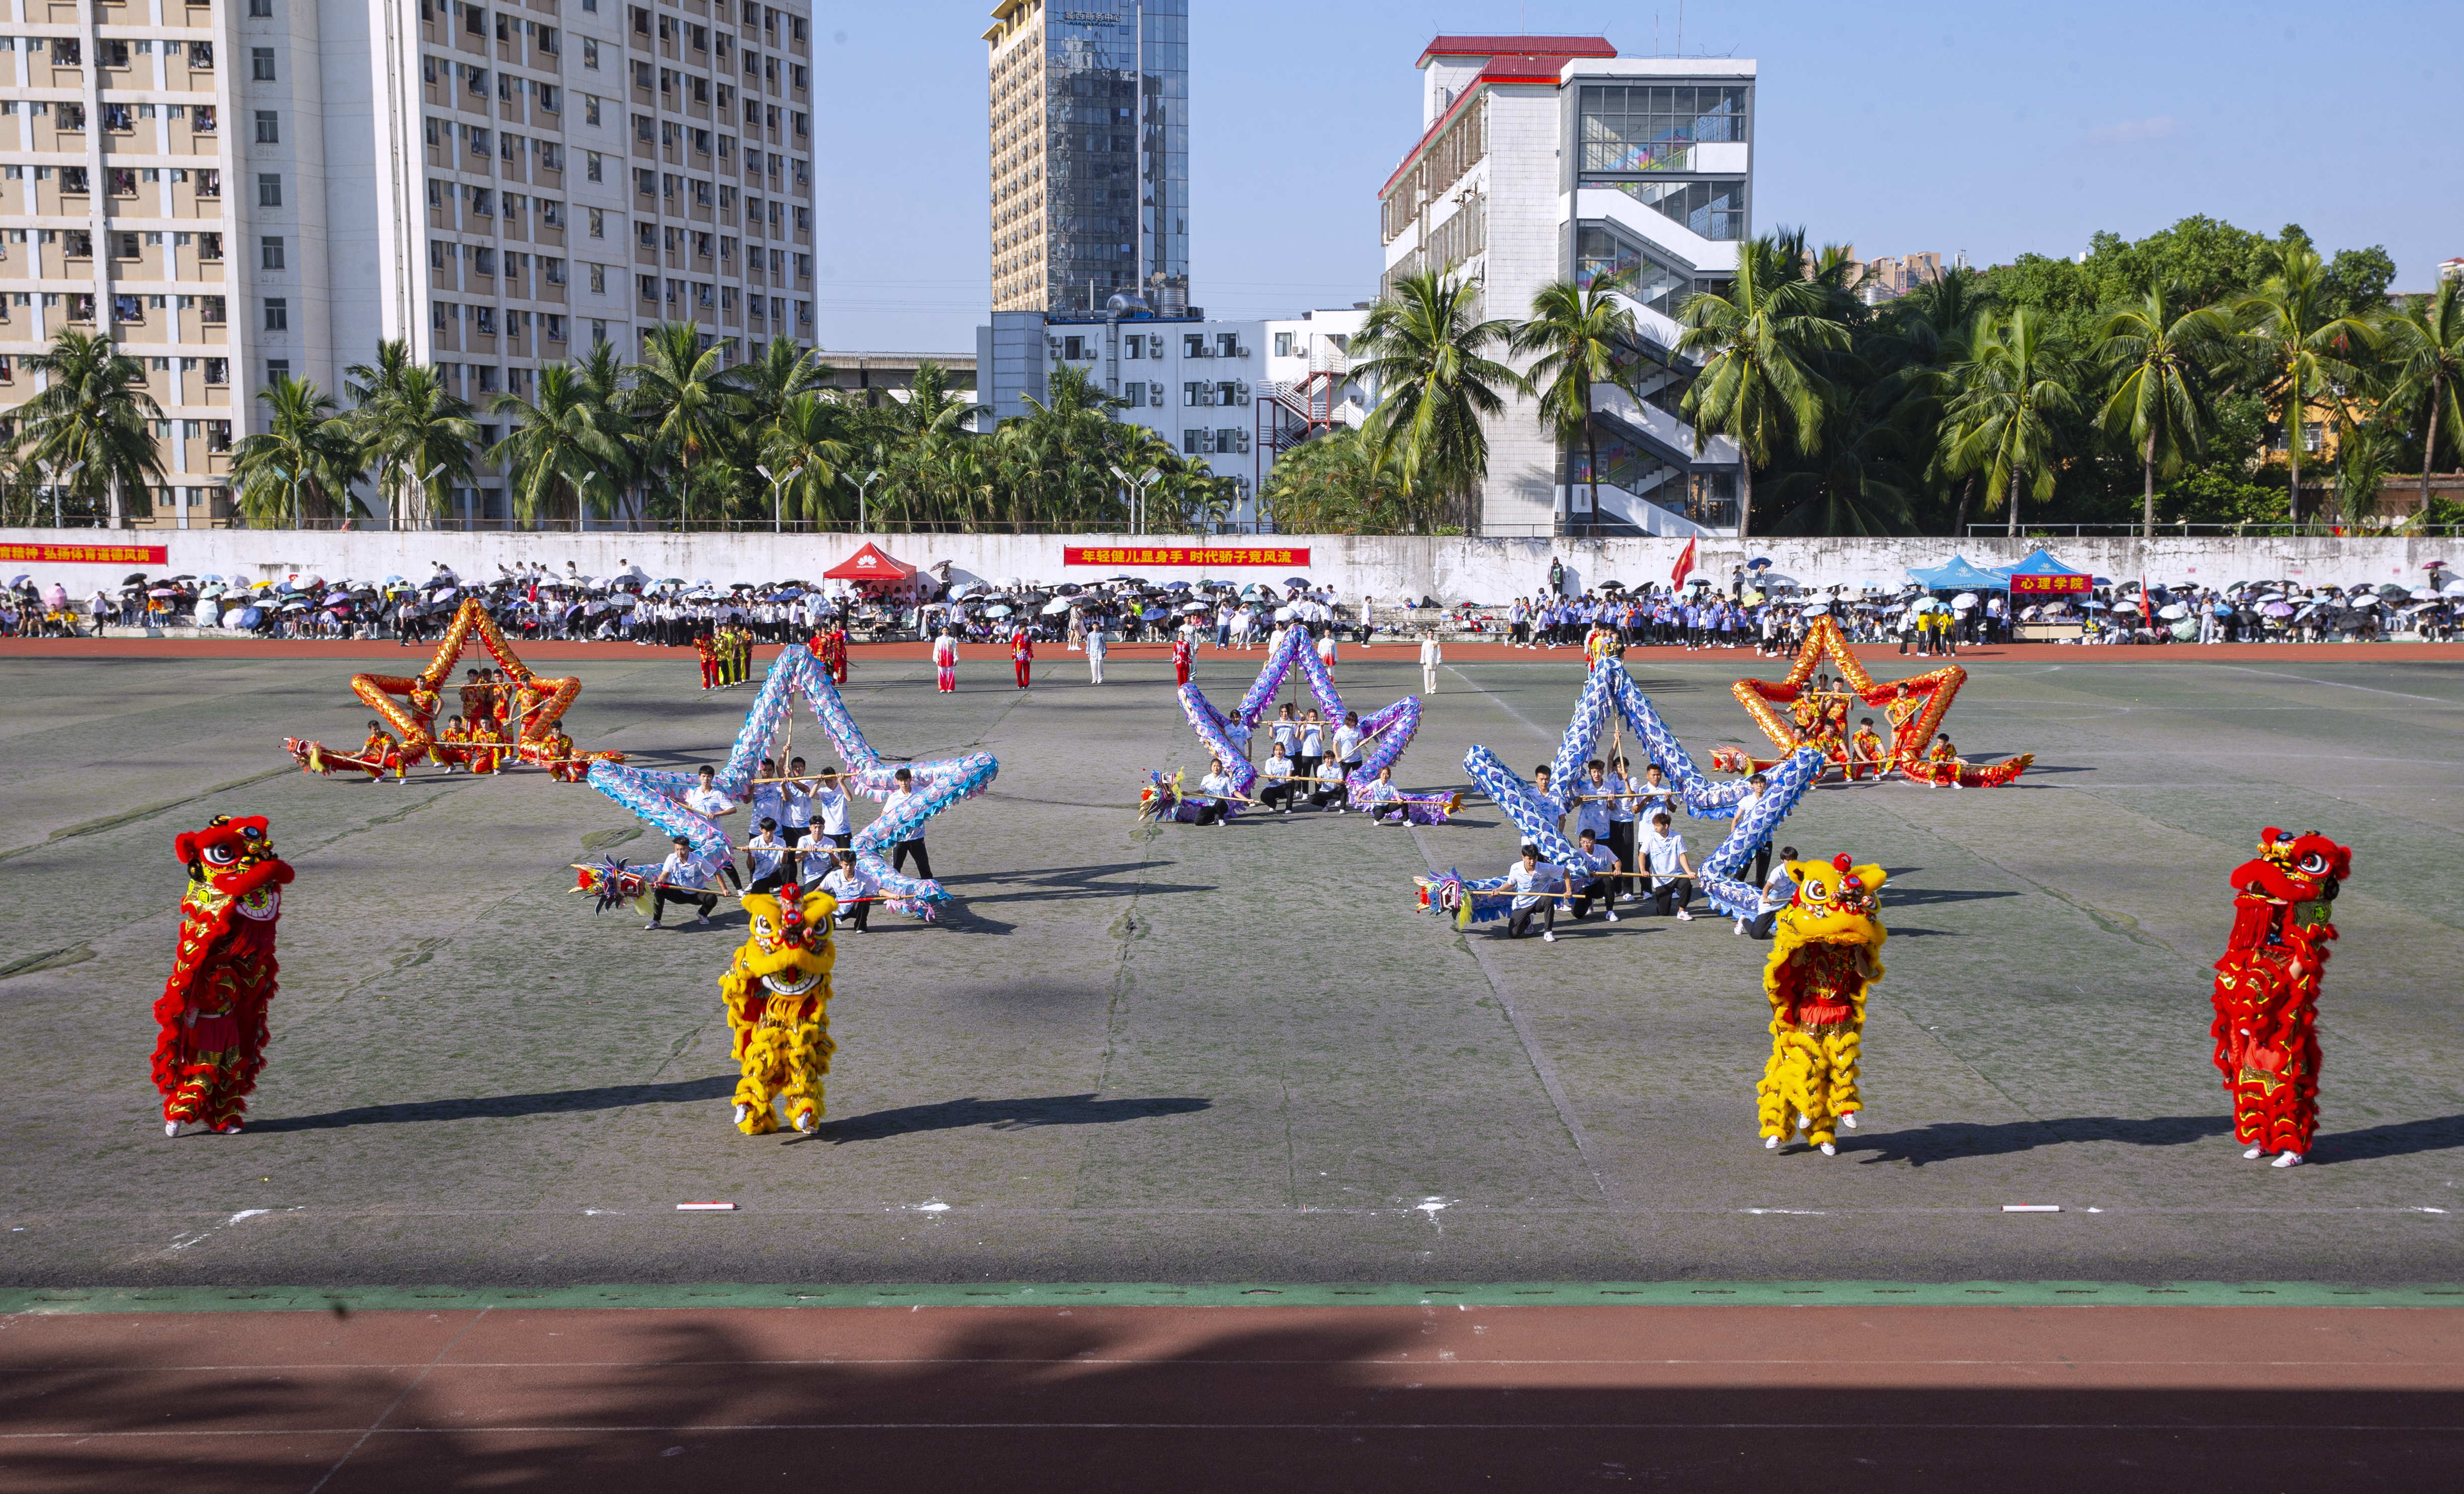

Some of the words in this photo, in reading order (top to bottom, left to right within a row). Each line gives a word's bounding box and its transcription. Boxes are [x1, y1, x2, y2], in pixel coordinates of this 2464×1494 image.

[1066, 11, 1122, 22] 城西商务中心
[0, 546, 38, 559] 育精神
[44, 547, 150, 561] 弘扬体育道德风尚
[1082, 550, 1183, 563] 年轻健儿显身手
[1190, 551, 1291, 563] 时代骄子竞风流
[2021, 577, 2084, 590] 心理学院
